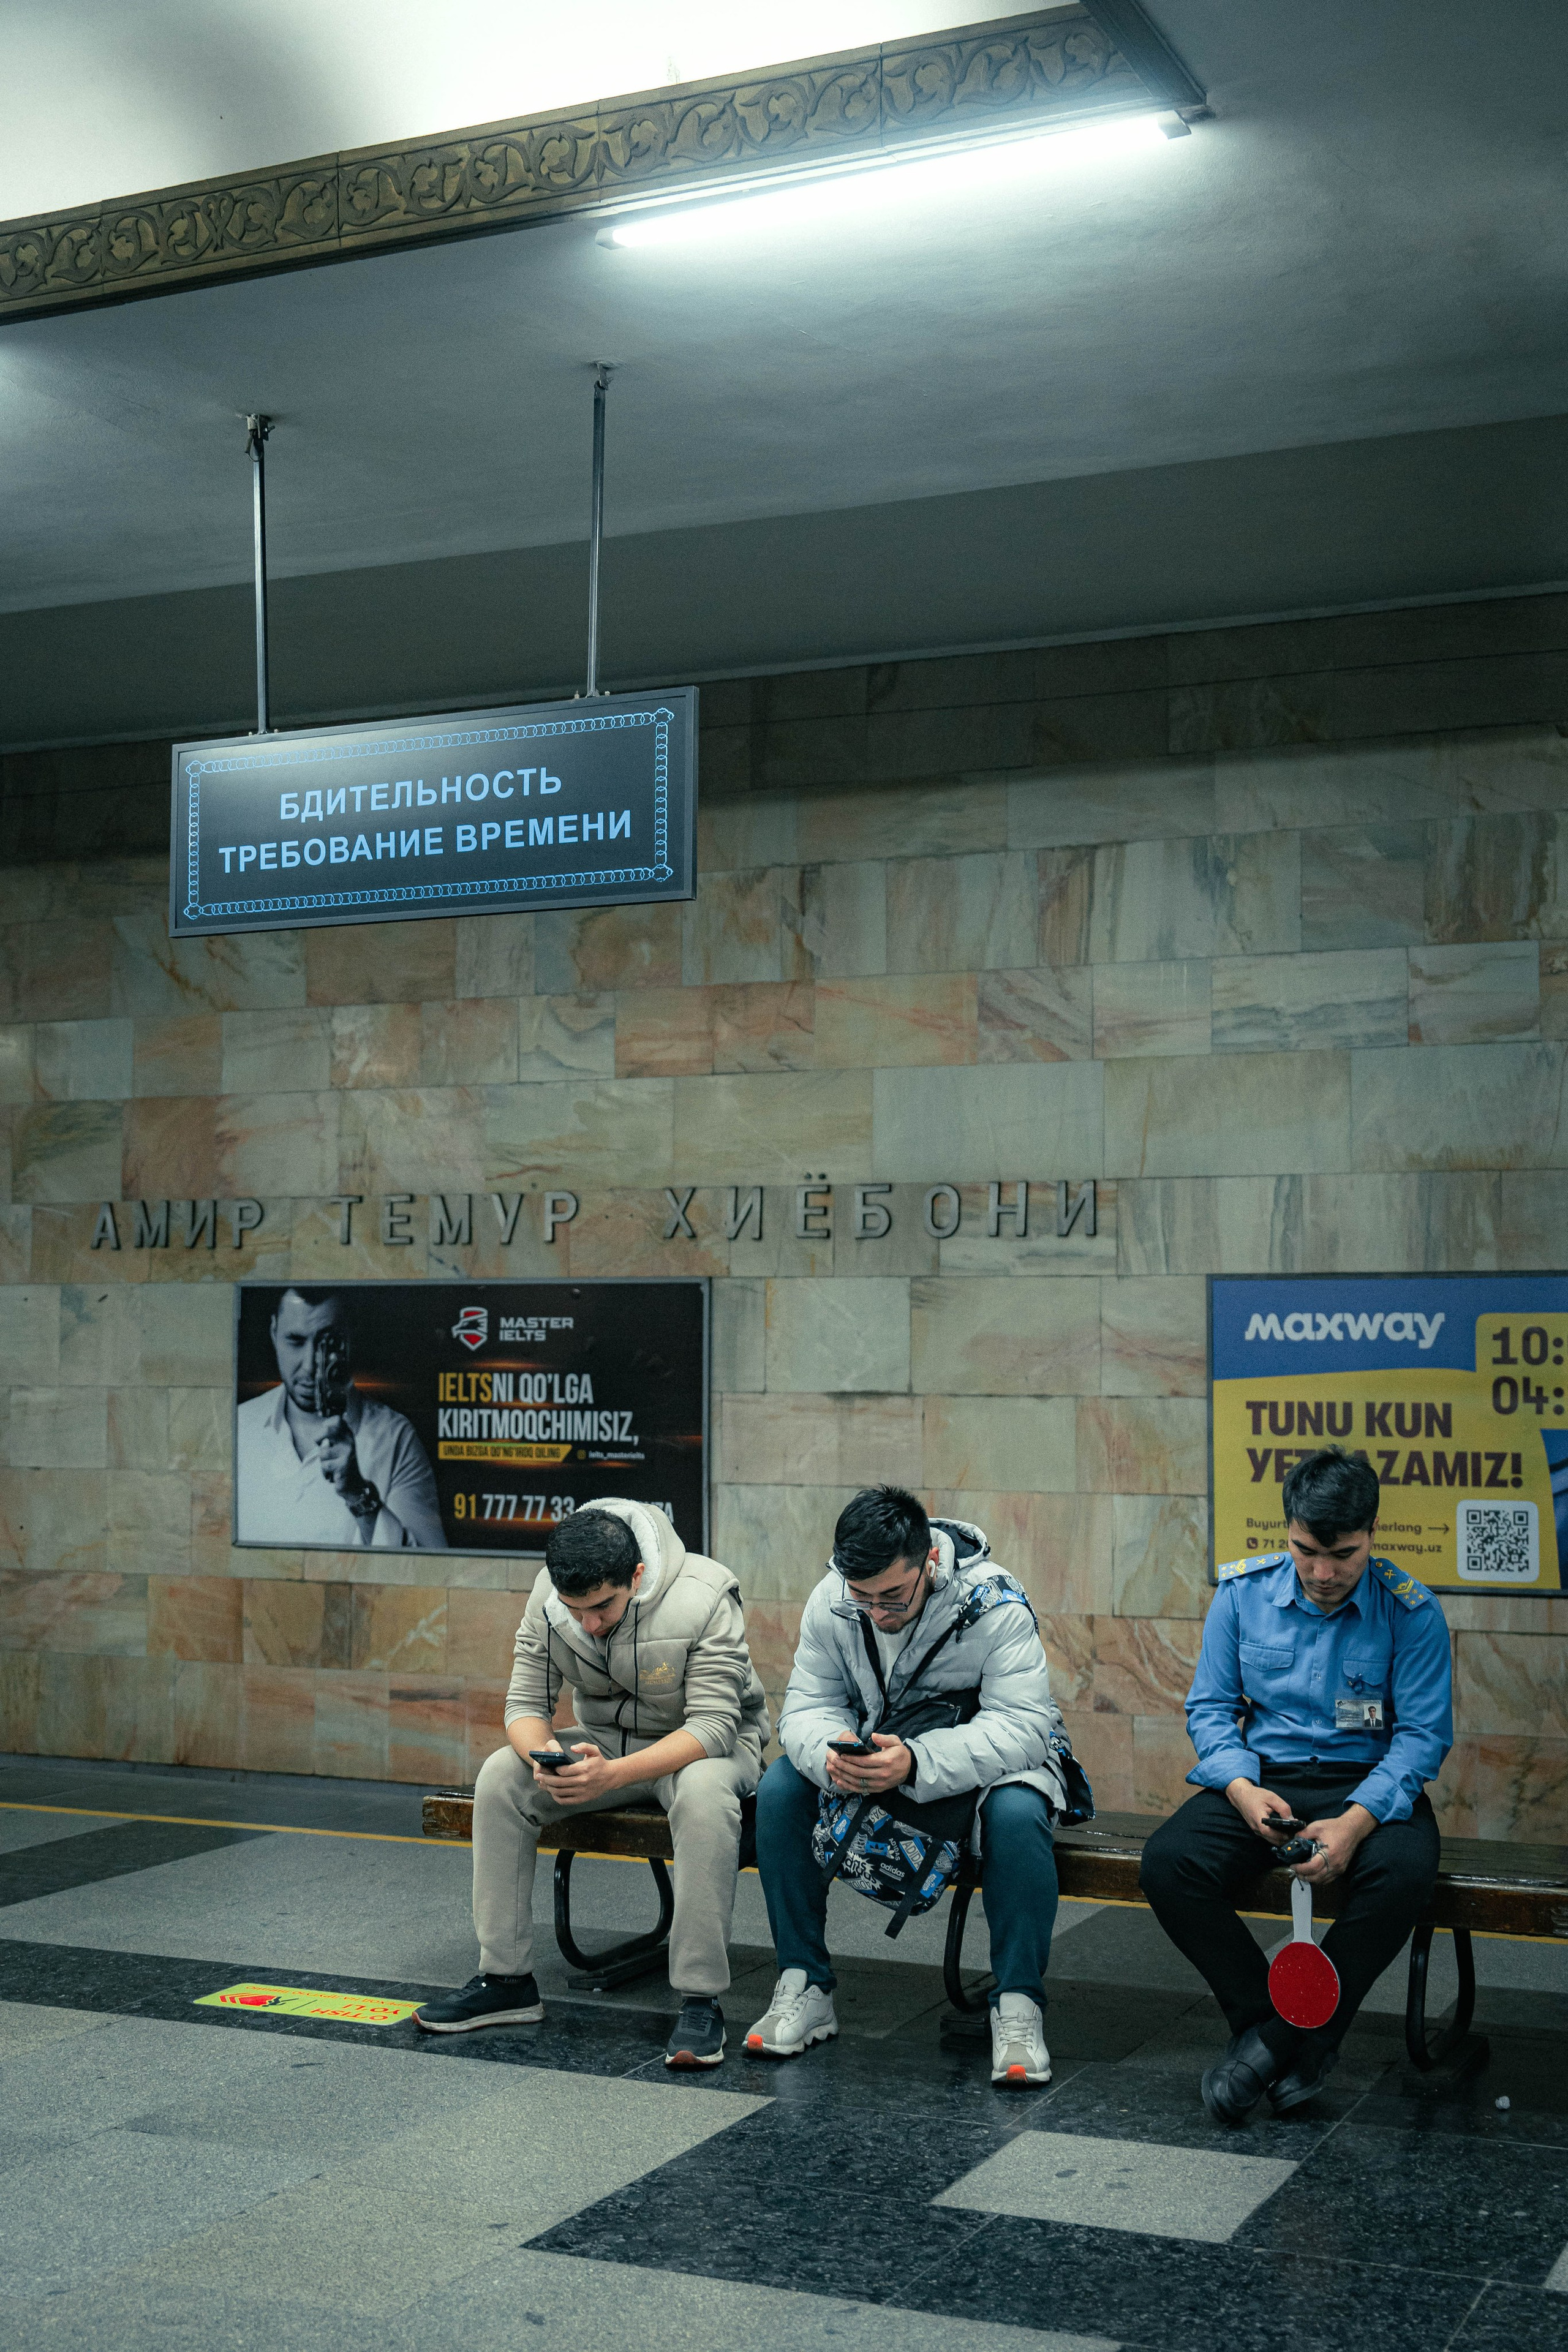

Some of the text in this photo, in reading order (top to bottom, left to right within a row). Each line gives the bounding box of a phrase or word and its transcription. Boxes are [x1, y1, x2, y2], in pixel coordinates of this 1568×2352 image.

[279, 765, 562, 823] БДИТЕЛЬНОСТЬ
[219, 810, 631, 873] ТРЕБОВАНИЕ ВРЕМЕНИ
[90, 1172, 1098, 1250] АМИР ТЕМУР ХИЁБОНИ
[500, 1317, 574, 1329] MASTER
[500, 1329, 546, 1341] IELTS
[1245, 1311, 1445, 1349] maxway
[438, 1373, 594, 1404] IELTSNI QO'LGA
[438, 1408, 639, 1446] KIRITMOQCHIMISIZ,
[1245, 1401, 1453, 1438] TUNU KUN
[454, 1493, 575, 1522] 91 777 77 33
[1263, 1538, 1274, 1548] 71
[889, 1838, 901, 1861] ADIDAS
[880, 1863, 905, 1878] adidas
